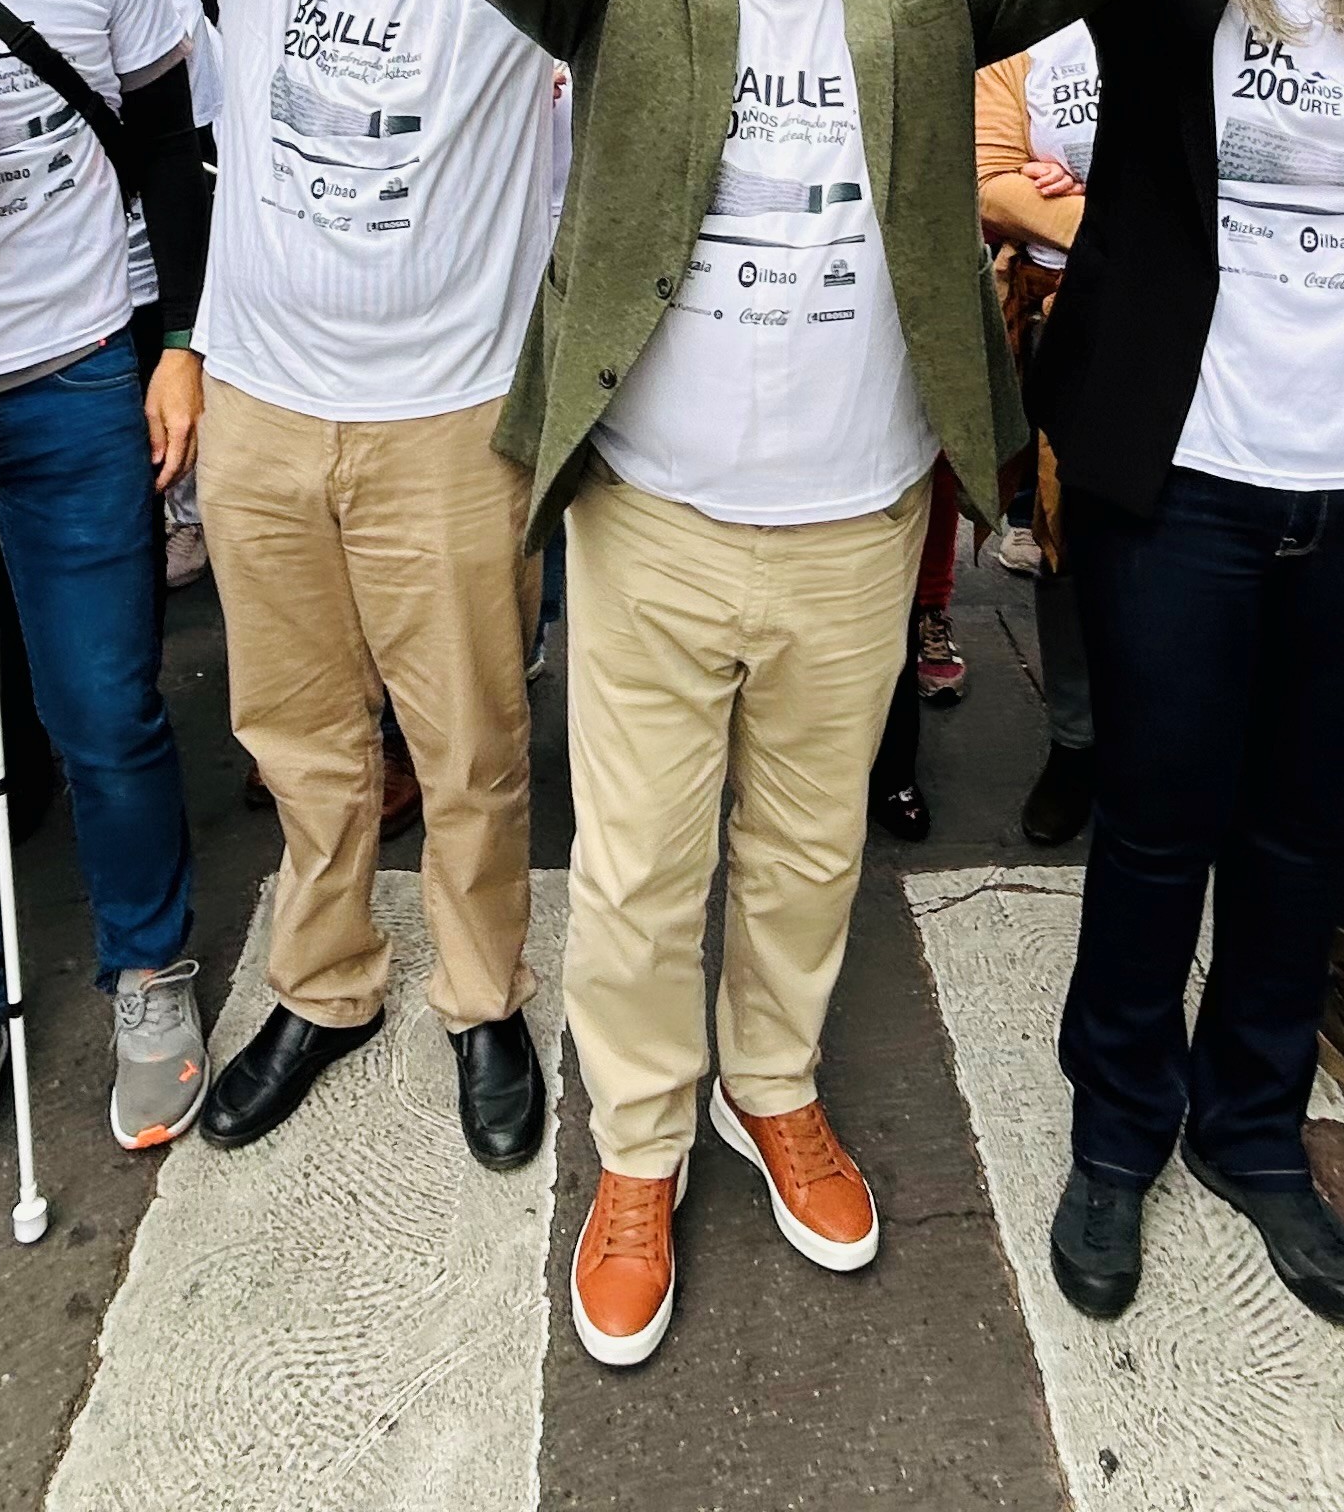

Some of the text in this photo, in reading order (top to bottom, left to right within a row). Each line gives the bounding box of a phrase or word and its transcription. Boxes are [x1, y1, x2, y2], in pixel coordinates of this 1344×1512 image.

[733, 66, 845, 108] AILLE
[1231, 68, 1299, 106] 200
[740, 105, 779, 128] AÑOS
[1299, 98, 1342, 117] URTE
[739, 126, 776, 143] URTE
[311, 176, 357, 200] Bilbao
[738, 261, 798, 288] Bilbao
